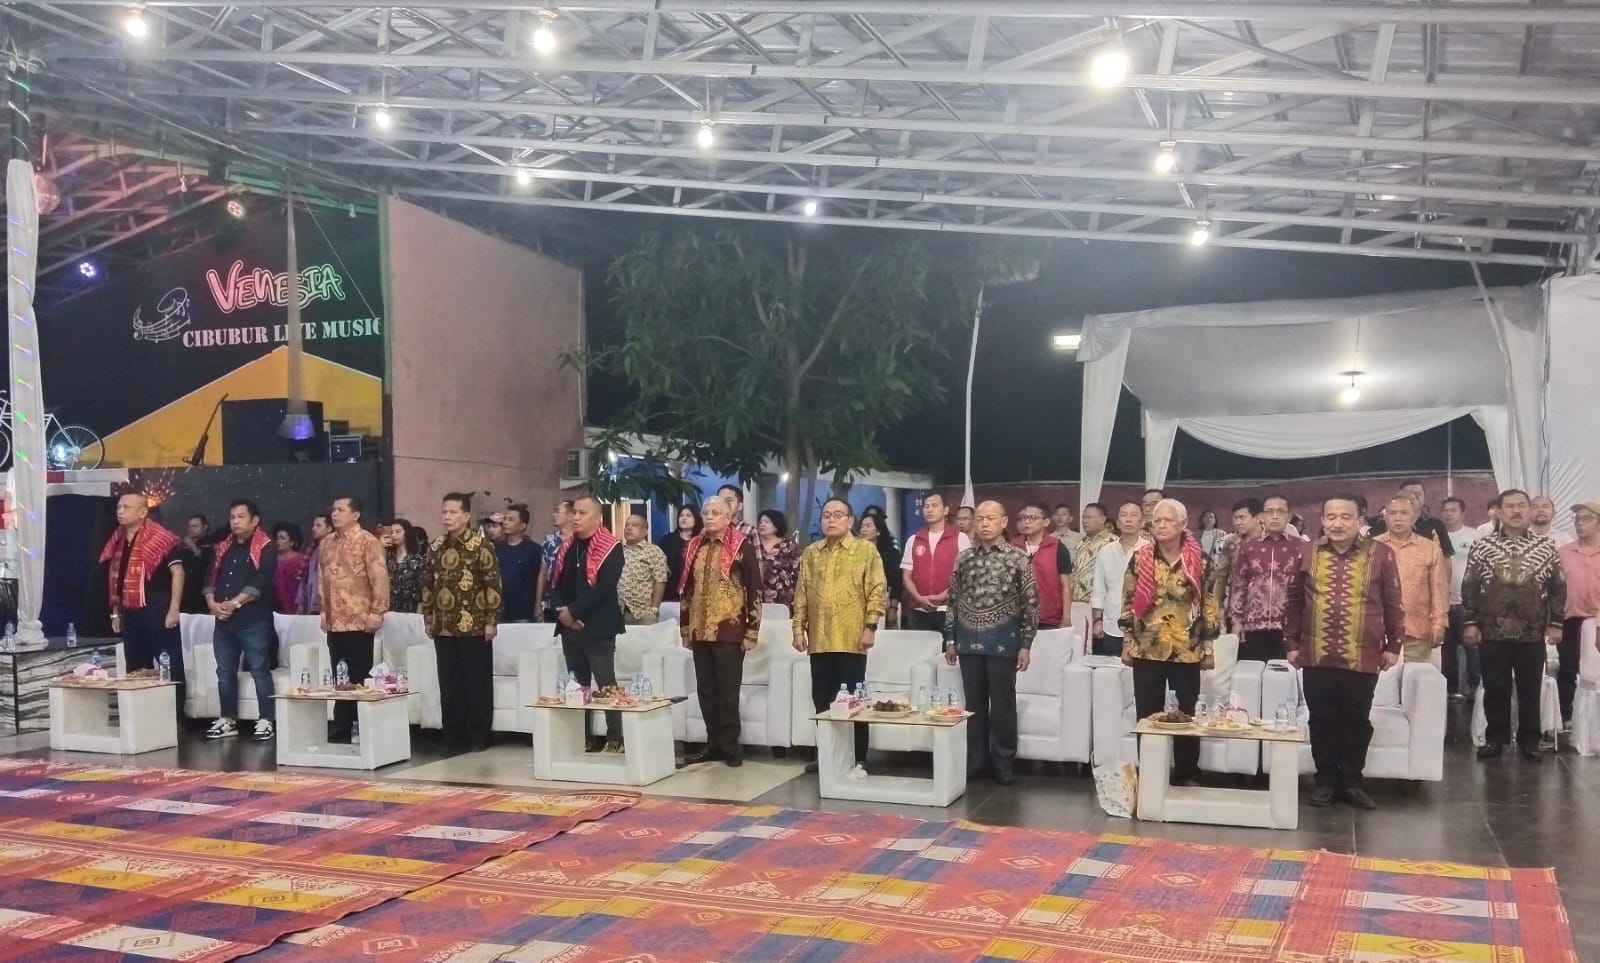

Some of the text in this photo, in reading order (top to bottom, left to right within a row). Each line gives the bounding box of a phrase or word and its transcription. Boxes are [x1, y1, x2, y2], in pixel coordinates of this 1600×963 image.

[182, 317, 381, 348] CIBUBUR LIE MUSIC
